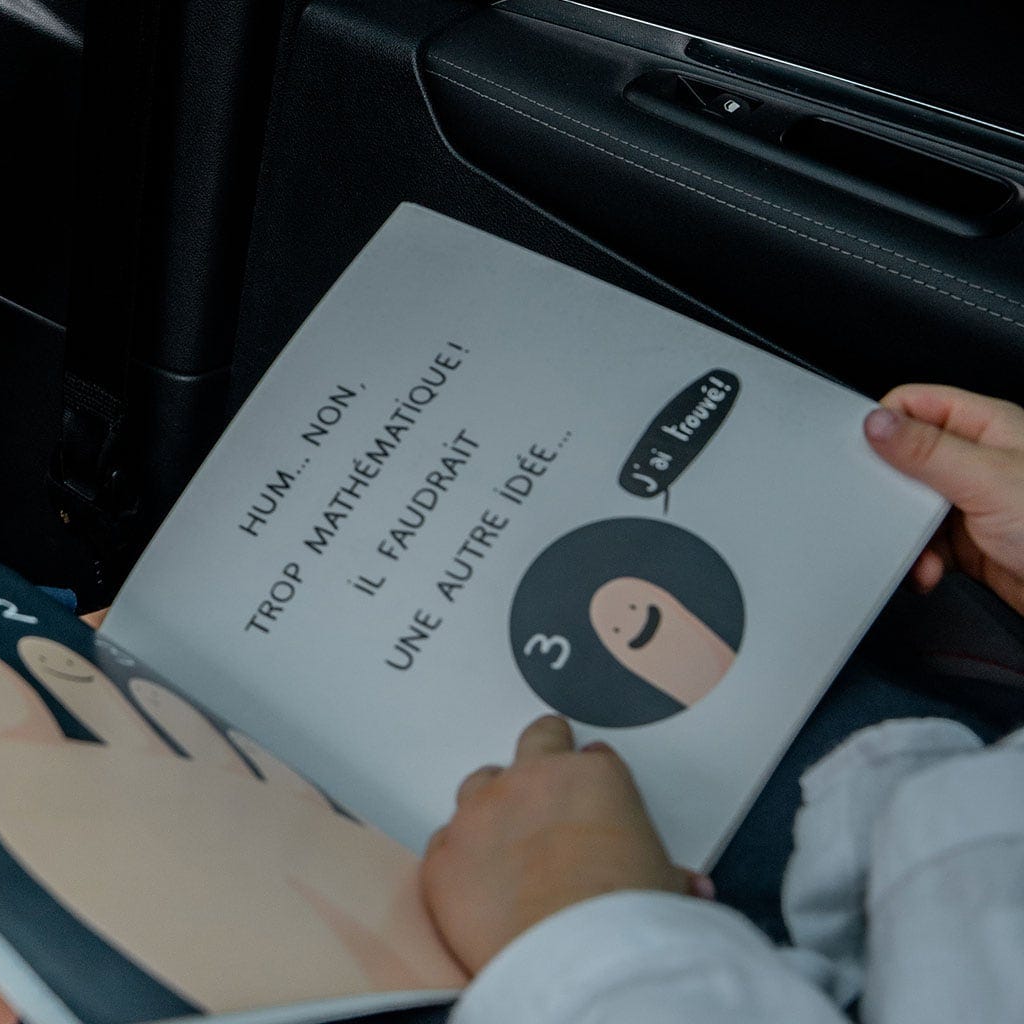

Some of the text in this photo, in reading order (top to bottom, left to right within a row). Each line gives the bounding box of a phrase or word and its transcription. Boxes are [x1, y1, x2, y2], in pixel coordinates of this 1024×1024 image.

[239, 382, 366, 537] HUM... NON,
[244, 562, 303, 635] TROP
[384, 608, 443, 672] UNE
[435, 509, 510, 603] AUTRE
[523, 633, 571, 670] 3
